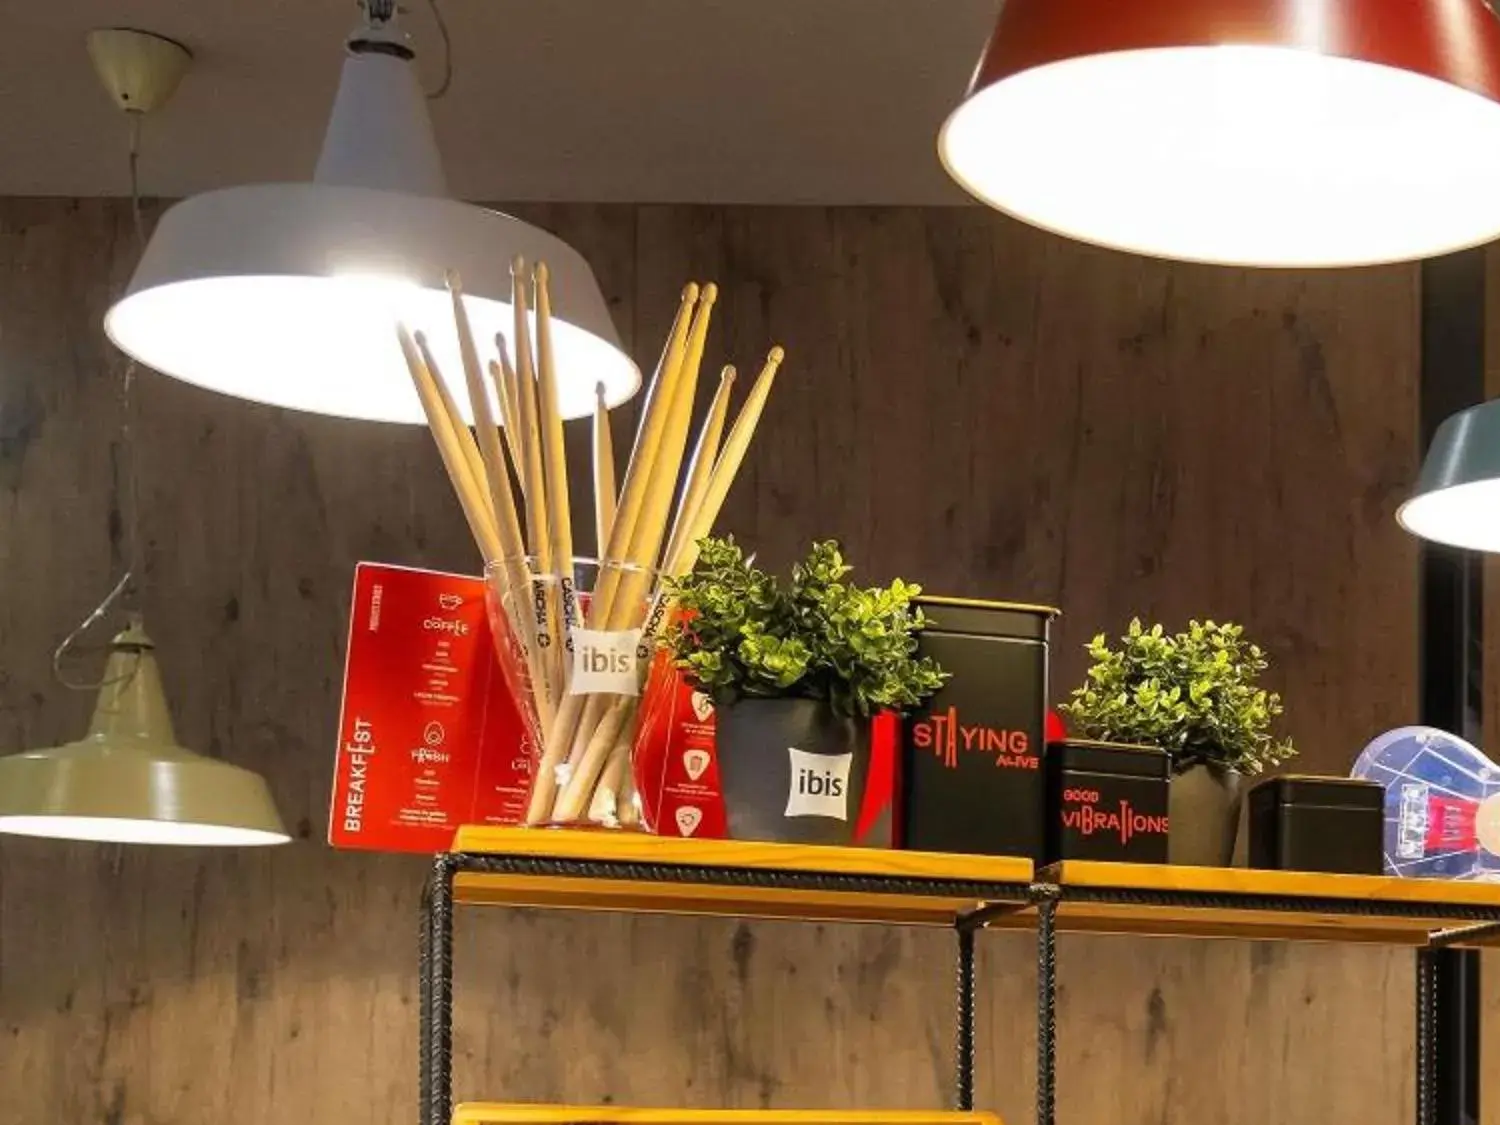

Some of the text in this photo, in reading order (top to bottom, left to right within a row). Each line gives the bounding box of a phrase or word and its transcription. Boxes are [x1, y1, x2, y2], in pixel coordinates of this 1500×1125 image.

[583, 647, 631, 673] ibis
[912, 705, 1029, 769] STAYING
[995, 755, 1040, 769] ALIVE
[799, 769, 843, 797] ibis
[1063, 788, 1099, 803] GOOD
[1061, 799, 1169, 845] VIBRATIONS
